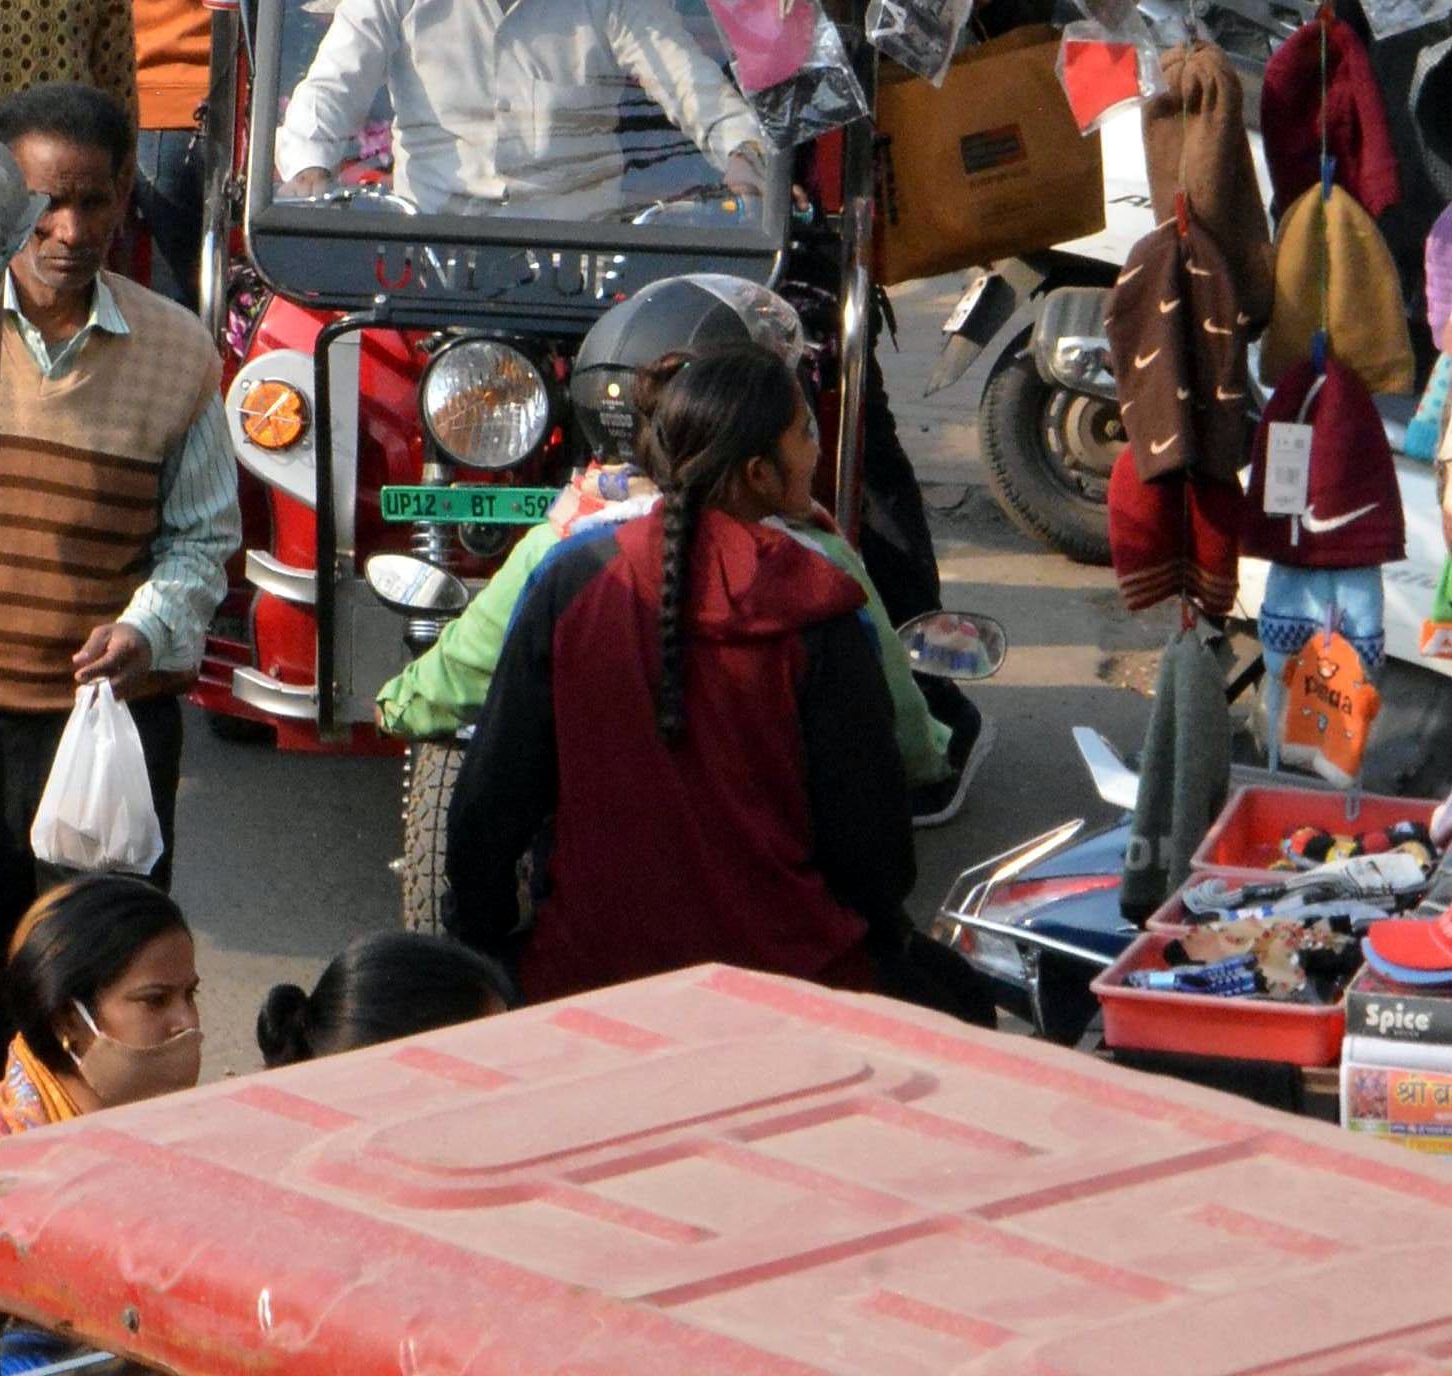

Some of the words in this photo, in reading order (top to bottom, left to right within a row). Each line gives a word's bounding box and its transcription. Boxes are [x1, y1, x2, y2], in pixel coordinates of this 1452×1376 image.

[386, 492, 437, 517] UP12
[471, 495, 497, 518] BT
[1365, 1003, 1430, 1035] Spice
